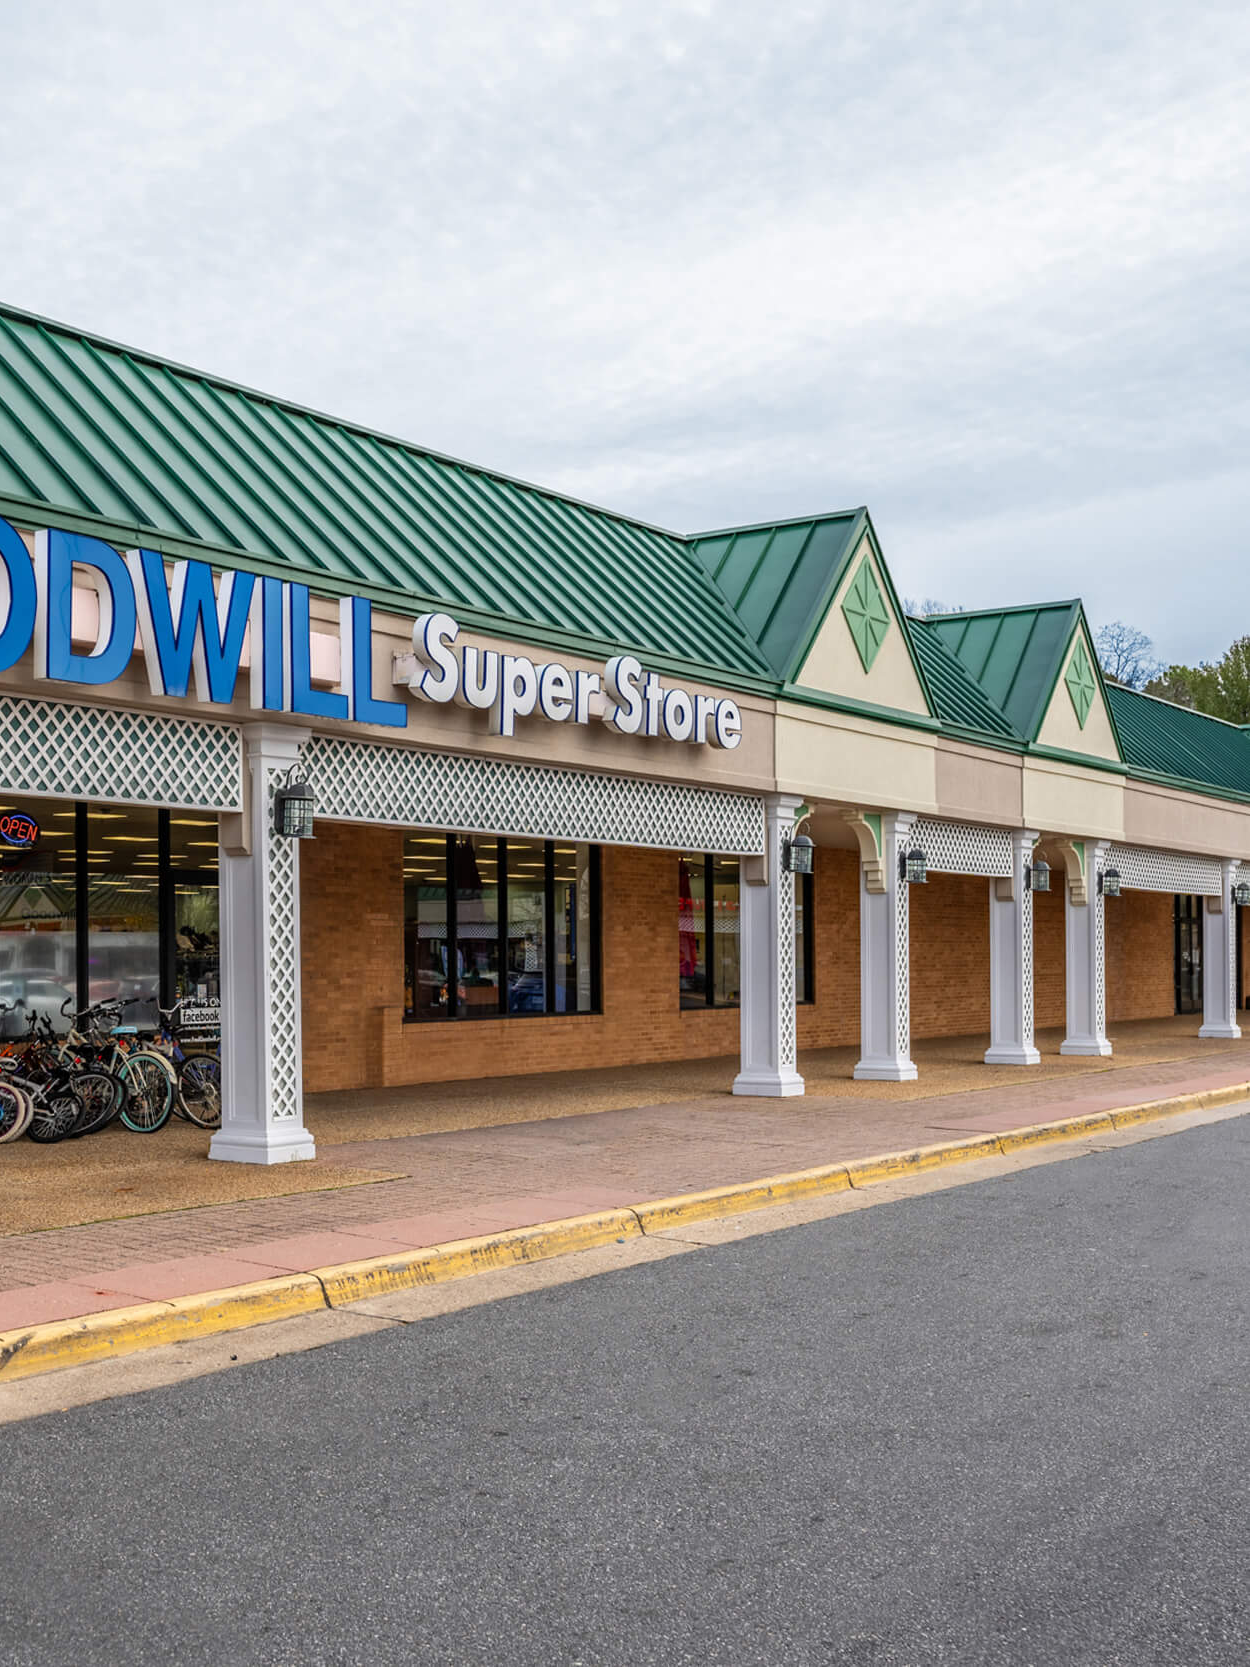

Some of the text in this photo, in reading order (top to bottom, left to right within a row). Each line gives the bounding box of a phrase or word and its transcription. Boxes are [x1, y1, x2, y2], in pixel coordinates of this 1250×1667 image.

[410, 612, 742, 750] Super Store
[0, 816, 38, 841] OPEN
[182, 1009, 220, 1022] facebook
